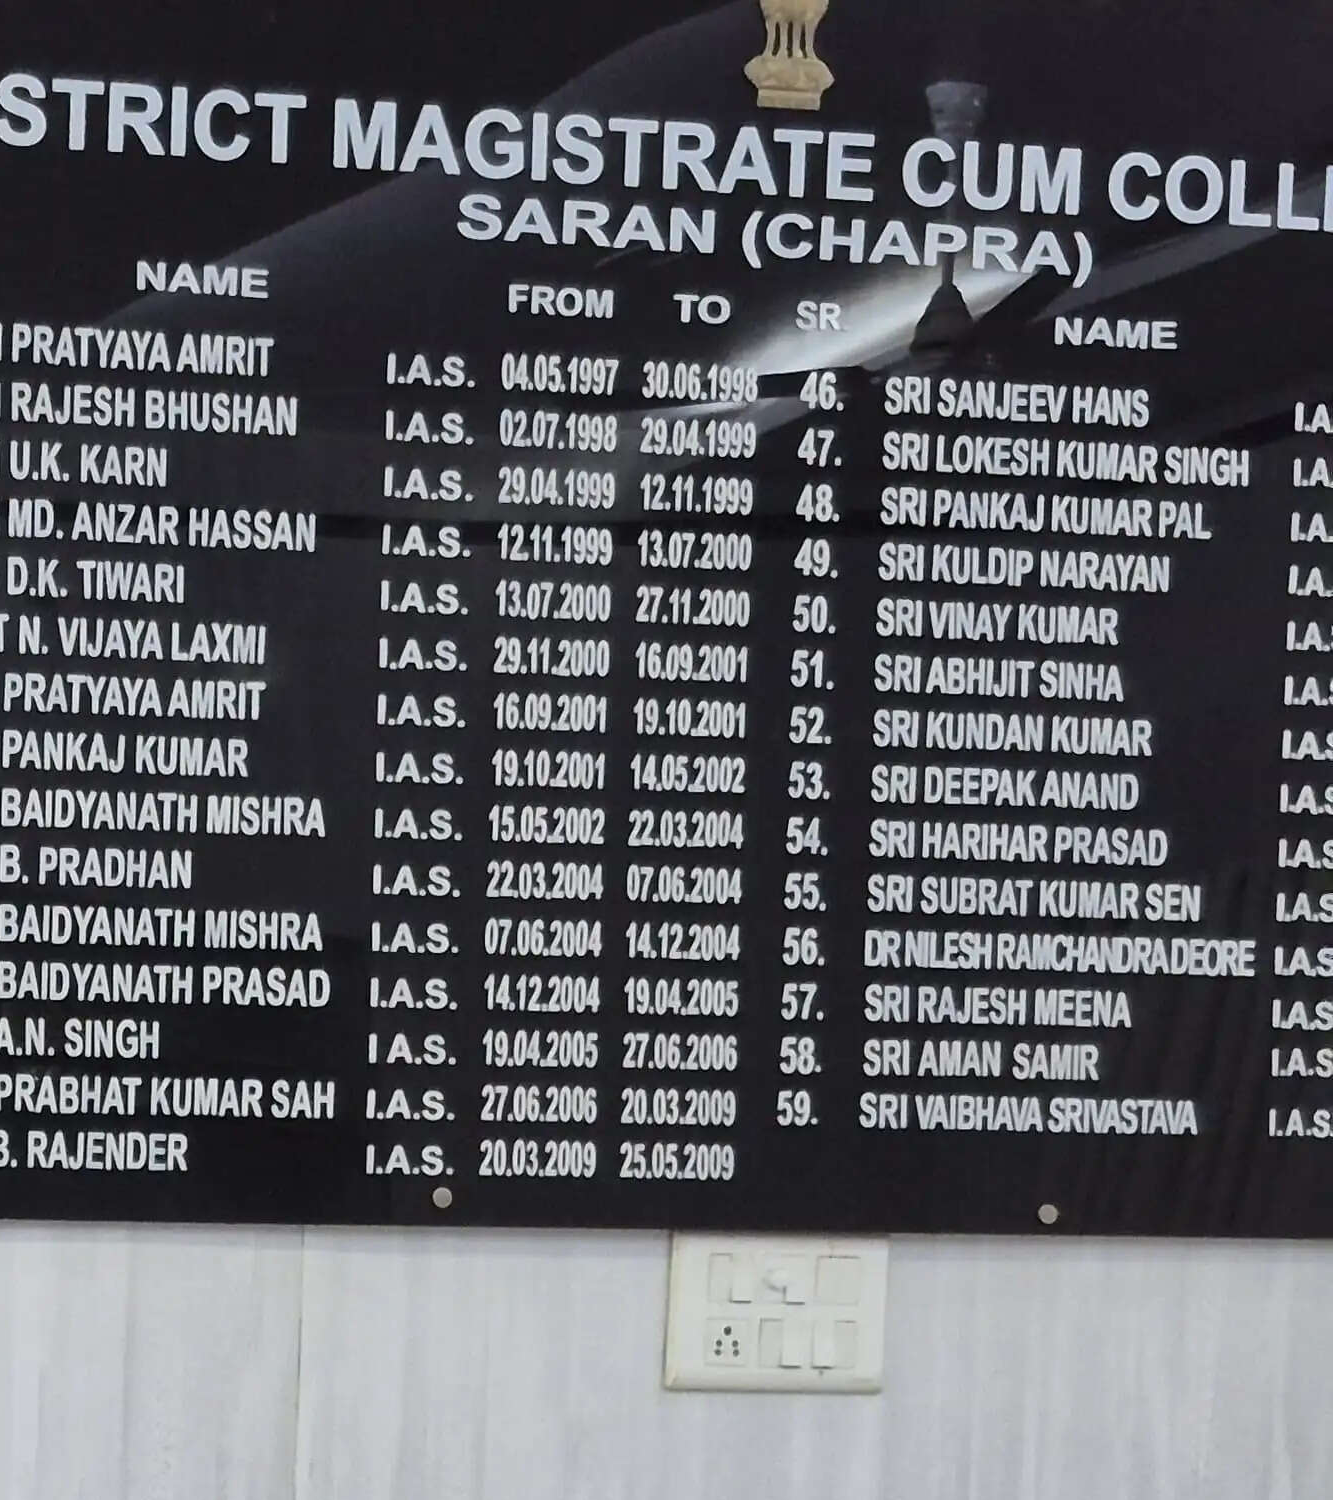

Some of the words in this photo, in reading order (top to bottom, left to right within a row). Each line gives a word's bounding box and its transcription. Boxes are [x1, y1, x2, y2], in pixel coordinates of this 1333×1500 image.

[332, 98, 876, 202] MAGISTRATE
[902, 137, 1083, 216] CUM
[457, 193, 717, 253] SARAN
[742, 212, 1093, 288] (CHAPRA)
[137, 261, 268, 298] NAME
[509, 285, 613, 318] FROM
[674, 294, 730, 323] TO
[1055, 317, 1177, 349] NAME
[12, 323, 171, 371] PRATYAYA
[176, 334, 274, 376] AMRIT
[387, 353, 475, 387] I.A.S.
[502, 353, 619, 395] 04.05.1997
[12, 382, 135, 427] RAJESH
[146, 390, 297, 436] BHUSHAN
[386, 410, 473, 445] I.A.S.
[500, 409, 617, 452] 02.07.1998
[640, 416, 756, 458] 29.04.1999
[800, 372, 843, 411] 46.
[885, 376, 930, 414] SRI
[938, 378, 1067, 422] SANJEEV
[1073, 386, 1149, 427] HANS
[10, 440, 69, 481] U.K.
[81, 444, 167, 486] KARN
[384, 466, 473, 501] I.A.S.
[499, 466, 615, 509] 29.04.1999
[641, 473, 753, 515] 12.11.1999
[798, 428, 841, 467] 47.
[883, 431, 929, 471] SRI
[936, 435, 1049, 475] LOKESH
[1057, 440, 1158, 483] KUMAR
[1164, 446, 1249, 486] SINGH
[9, 498, 63, 539] MD.
[72, 502, 178, 545] ANZAR
[189, 508, 316, 552] HASSAN
[382, 524, 470, 557] I.A.S.
[498, 523, 612, 565] 12.11.1999
[638, 530, 752, 570] 13.07.2000
[796, 484, 839, 522] 48.
[881, 487, 927, 526] SRI
[933, 489, 1044, 532] PANKAJ
[1052, 495, 1152, 536] KUMAR
[1159, 501, 1211, 539] PAL
[8, 556, 67, 597] D.K.
[76, 560, 184, 603] TIWARI
[381, 580, 468, 614] I.A.S.
[496, 580, 611, 621] 13.07.2000
[636, 585, 750, 627] 27.11.2000
[794, 538, 837, 578] 49.
[878, 542, 924, 581] SRI
[932, 544, 1033, 586] KULDIP
[1040, 550, 1169, 592] NARAYAN
[793, 595, 835, 633] 50.
[876, 598, 923, 636] SRI
[929, 602, 1012, 641] VINAY
[1018, 604, 1118, 645] KUMAR
[19, 615, 48, 654] N.
[58, 617, 163, 659] VIJAYA
[172, 622, 266, 664] LAXMI
[380, 637, 467, 671] I.A.S.
[494, 636, 609, 677] 29.11.2000
[636, 642, 747, 682] 16.09.2001
[791, 650, 834, 689] 51.
[874, 654, 921, 693] SRI
[926, 657, 1035, 697] ABHIJIT
[1040, 660, 1123, 701] SINHA
[3, 730, 125, 772] PANKAJ
[136, 735, 248, 777] KUMAR
[376, 752, 463, 784] I.A.S.
[492, 749, 605, 789] 19.10.2001
[631, 754, 745, 793] 14.05.2002
[788, 761, 830, 799] 53.
[871, 765, 917, 803] SRI
[924, 766, 1036, 806] DEEPAK
[1040, 770, 1138, 810] ANAND
[1, 788, 197, 833] BAIDYANATH
[207, 795, 325, 837] MISHRA
[375, 808, 462, 840] I.A.S.
[489, 805, 605, 844] 15.05.2002
[628, 810, 743, 849] 22.03.2004
[786, 817, 827, 855] 54.
[869, 819, 915, 858] SRI
[922, 821, 1047, 861] HARIHAR
[1054, 827, 1168, 866] PRASAD
[0, 844, 28, 883] B.
[39, 847, 192, 888] PRADHAN
[373, 864, 460, 897] I.A.S.
[486, 860, 603, 900] 22.03.2004
[627, 864, 742, 904] 07.06.2004
[784, 873, 826, 911] 55.
[868, 874, 913, 912] SRI
[921, 876, 1033, 916] SUBRAT
[1040, 880, 1139, 919] KUMAR
[1145, 883, 1200, 921] SEN
[203, 966, 330, 1007] PRASAD
[370, 978, 457, 1009] I.A.S.
[484, 974, 600, 1013] 14.12.2004
[625, 977, 738, 1016] 19.04.2005
[781, 983, 823, 1020] 57.
[865, 984, 909, 1022] SRI
[918, 986, 1026, 1025] RAJESH
[1035, 989, 1131, 1027] MEENA
[780, 1037, 821, 1074] 58.
[863, 1039, 909, 1076] SRI
[918, 1040, 1001, 1076] AMAN
[1013, 1043, 1098, 1080] SAMIR
[151, 1077, 262, 1117] KUMAR
[271, 1080, 334, 1118] SAH
[366, 1089, 454, 1120] I.A.S.
[481, 1085, 597, 1123] 27.06.2006
[621, 1088, 736, 1126] 20.03.2009
[777, 1090, 818, 1126] 59.
[860, 1092, 907, 1129] SRI
[915, 1095, 1043, 1131] VAIBHAVA
[1048, 1097, 1197, 1135] SRIVASTAVA
[28, 1131, 187, 1171] RAJENDER
[366, 1145, 453, 1175] I.A.S.
[479, 1139, 596, 1177] 20.03.2009
[620, 1142, 734, 1180] 25.05.2009
